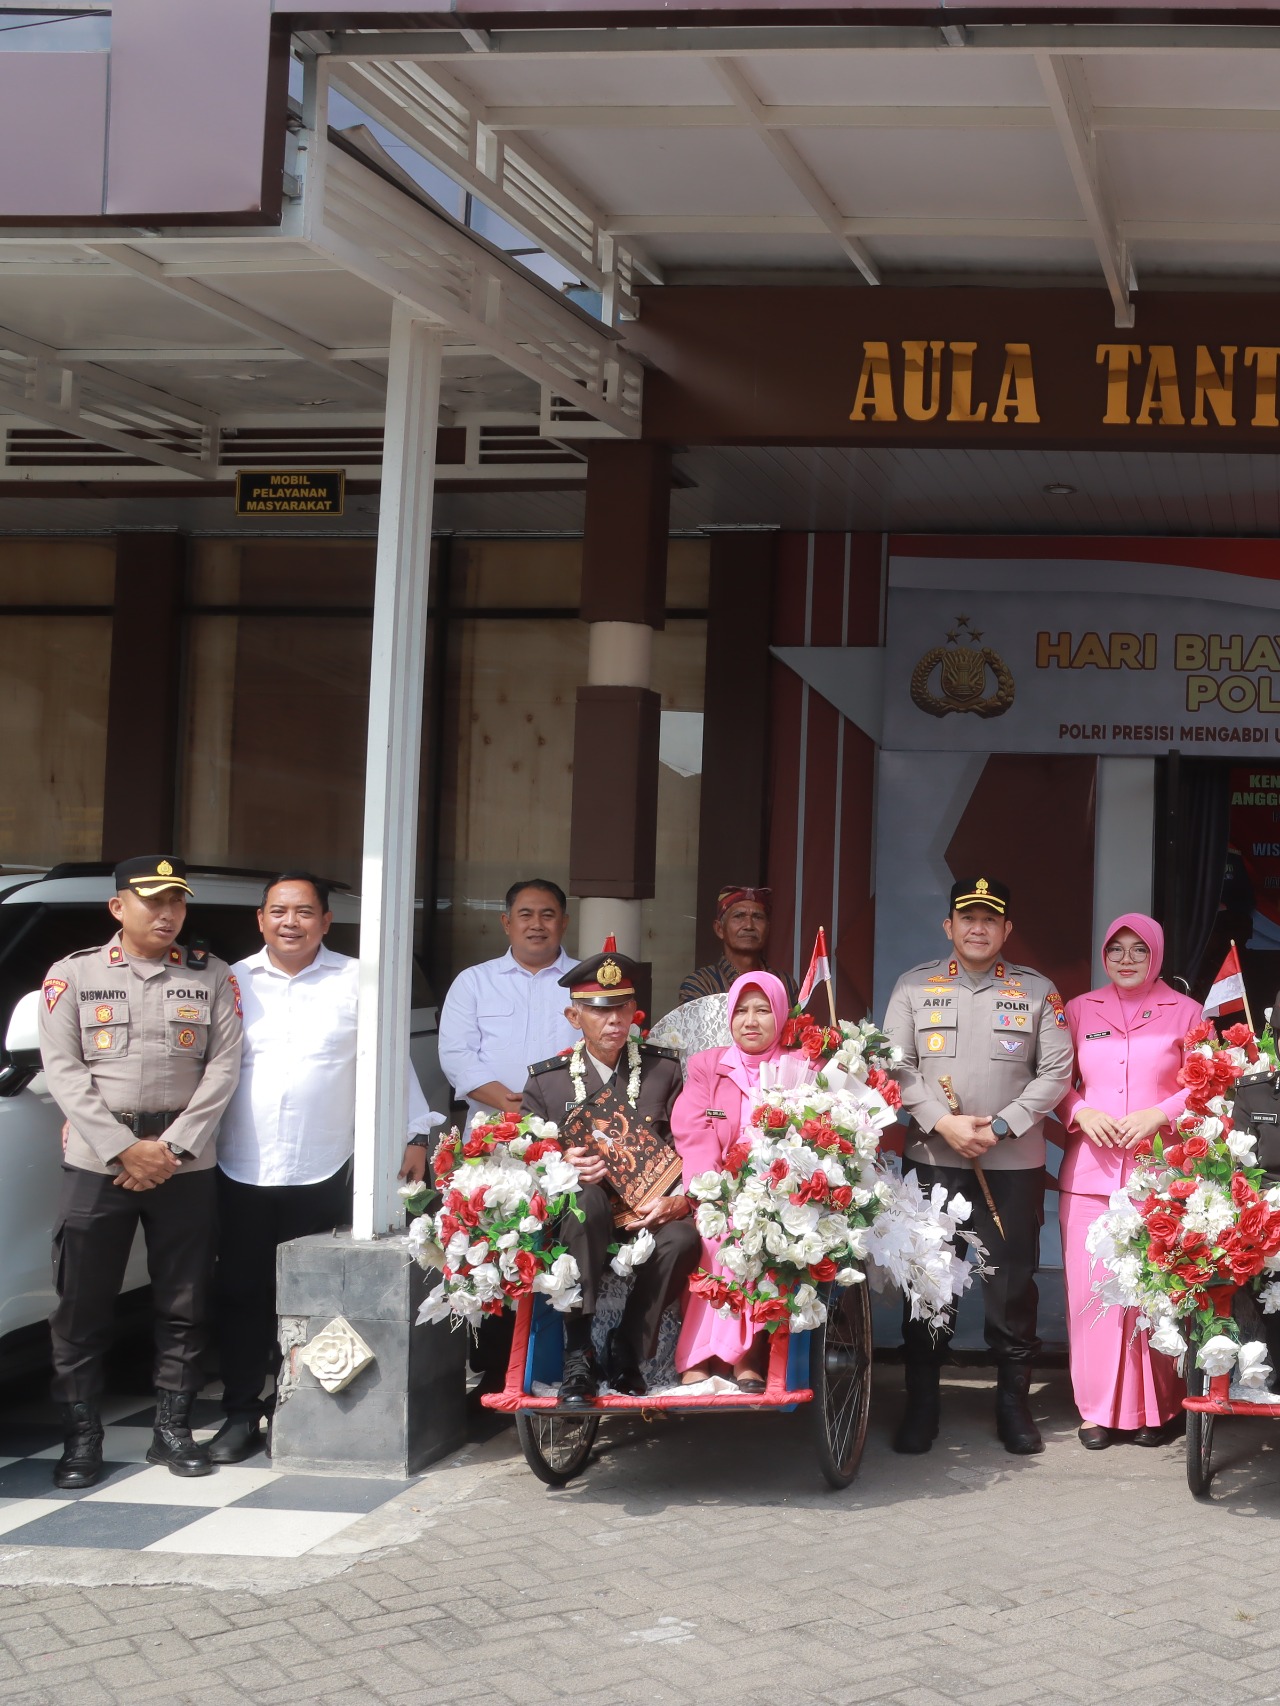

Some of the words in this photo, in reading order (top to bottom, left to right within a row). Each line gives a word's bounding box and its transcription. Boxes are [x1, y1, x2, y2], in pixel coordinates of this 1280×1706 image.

[849, 340, 1041, 423] AULA
[270, 475, 311, 485] MOBIL
[253, 488, 327, 498] PELAYANAN
[246, 501, 332, 511] MASYARAKAT
[1035, 631, 1158, 669] HARI
[1059, 723, 1106, 740] POLRI
[1112, 724, 1174, 741] PRESISI
[1180, 725, 1269, 743] MENGABDI
[80, 989, 127, 1002] SISWANTO
[166, 988, 209, 1001] POLRI
[923, 998, 952, 1007] ARIF
[996, 1001, 1029, 1011] POLRI
